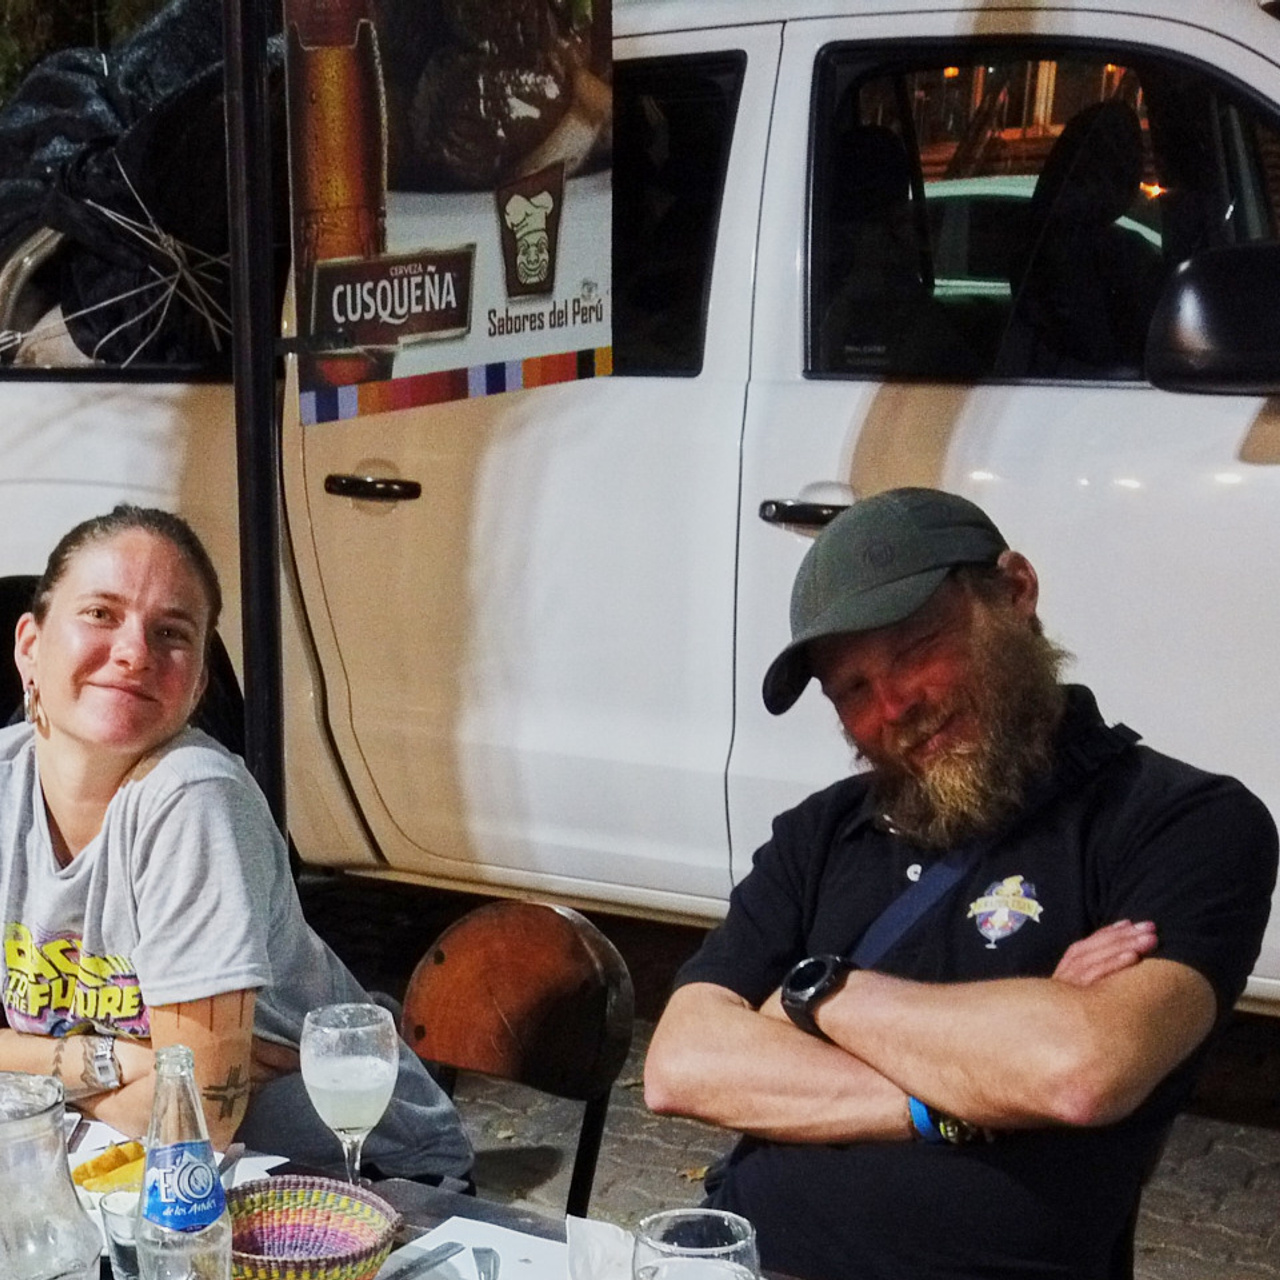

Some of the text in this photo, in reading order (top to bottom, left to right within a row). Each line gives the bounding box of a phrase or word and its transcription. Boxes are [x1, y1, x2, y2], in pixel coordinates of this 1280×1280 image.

[390, 263, 423, 276] CERVEZA
[332, 265, 456, 325] CUSQUEÑA
[488, 298, 603, 337] Sabores del Perú
